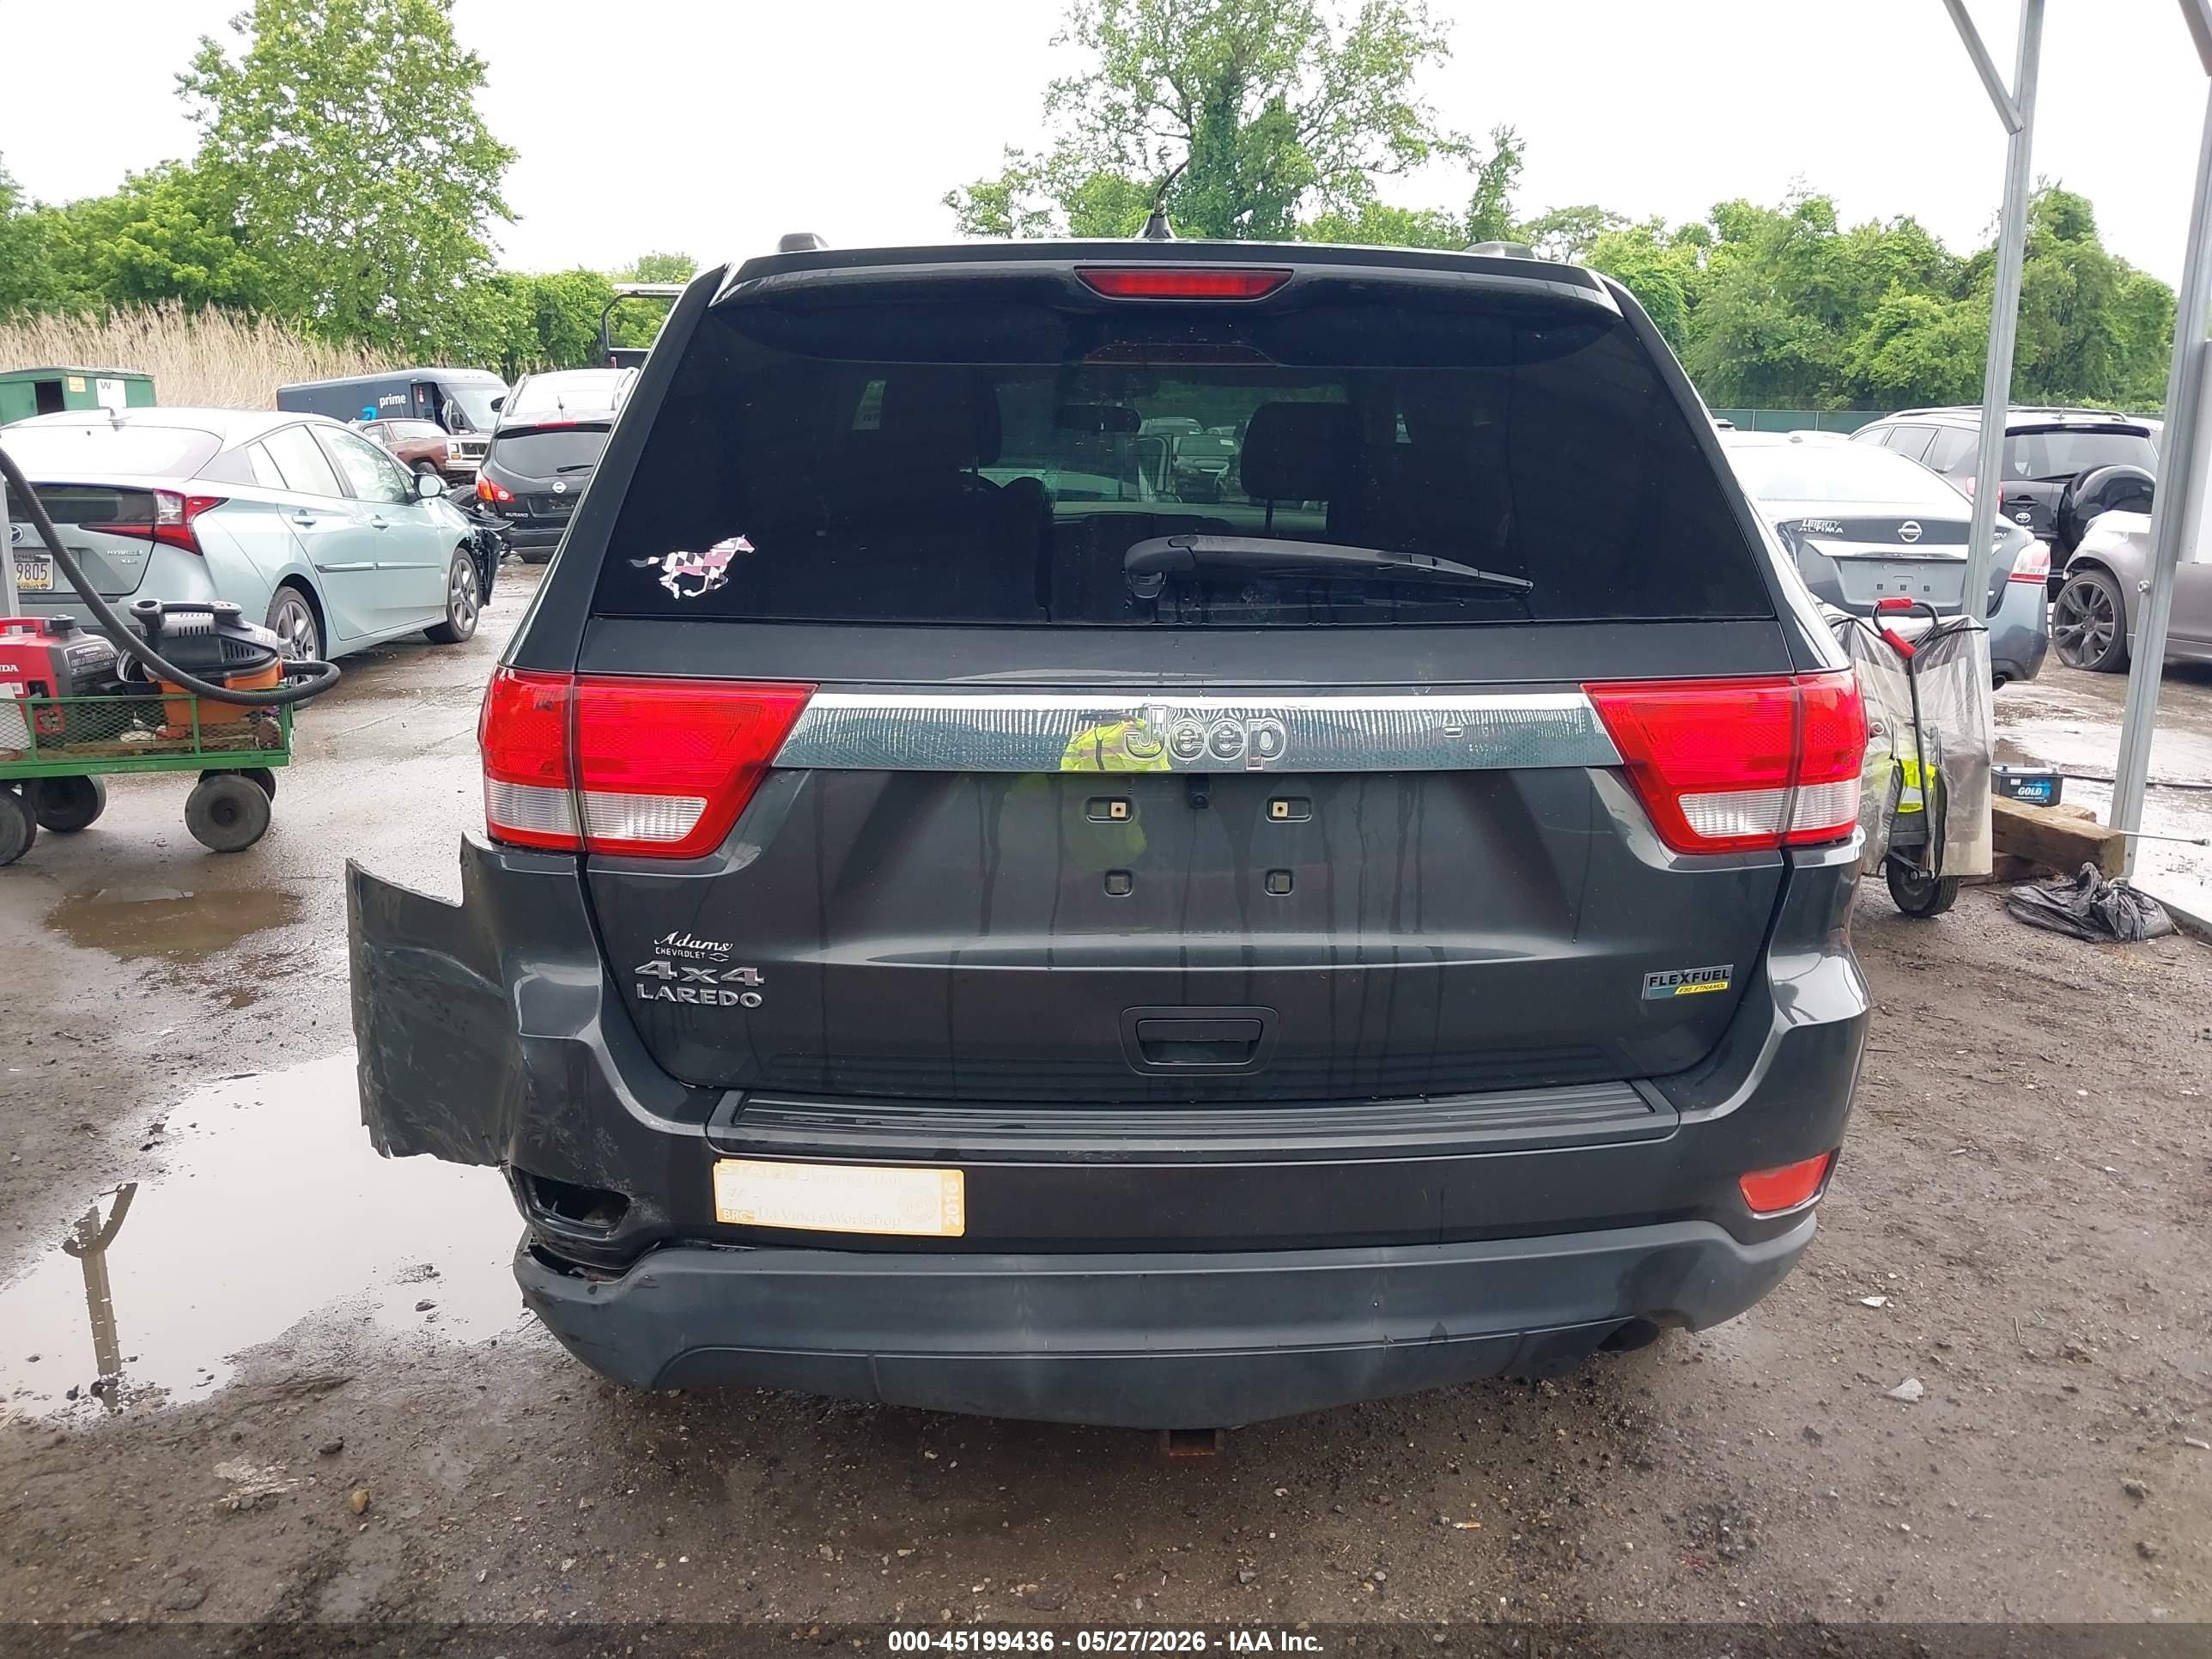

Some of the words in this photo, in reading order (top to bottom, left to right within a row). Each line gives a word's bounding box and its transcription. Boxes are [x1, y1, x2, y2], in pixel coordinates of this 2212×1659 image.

[379, 392, 406, 410] prime
[1802, 519, 1841, 528] LIBERTY
[1123, 705, 1290, 770] Jeep
[2017, 786, 2043, 796] GOLD
[653, 930, 733, 952] Adams
[655, 946, 706, 960] CHEVROLET
[1649, 969, 1730, 987] FLEXFUEL
[635, 982, 763, 1009] LAREDO
[945, 1181, 960, 1226] 2016
